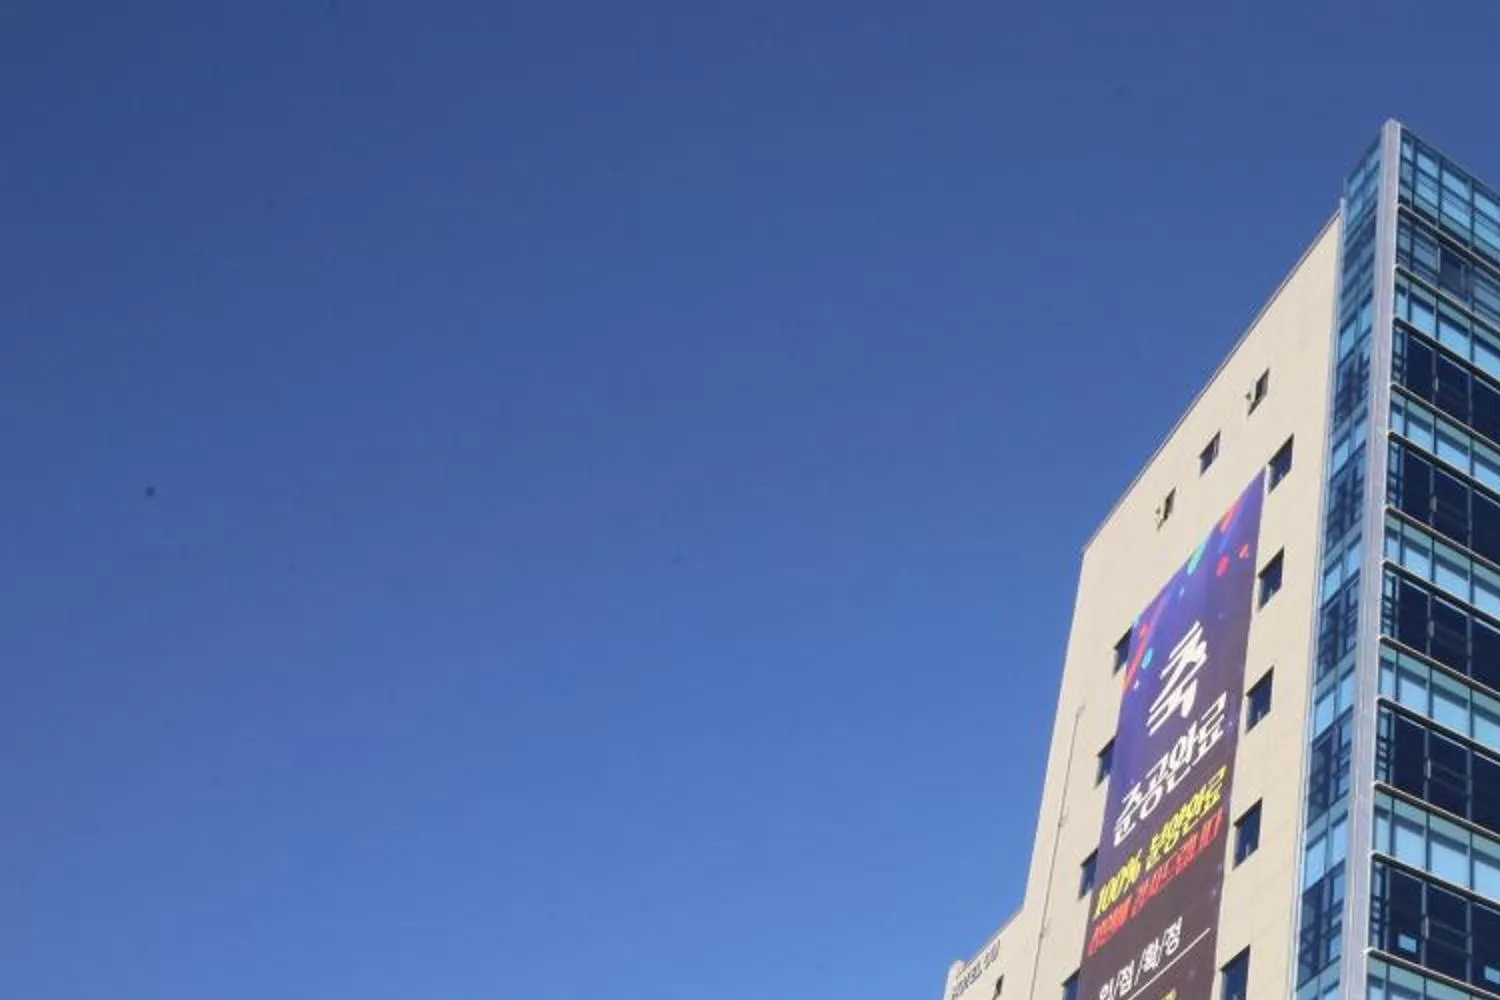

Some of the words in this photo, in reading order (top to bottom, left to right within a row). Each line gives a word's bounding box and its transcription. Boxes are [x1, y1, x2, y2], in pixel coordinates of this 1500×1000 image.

[1148, 623, 1207, 734] 축
[1095, 850, 1142, 918] 100%
[1146, 768, 1225, 870] 분양완료
[1114, 695, 1226, 844] 준공완료
